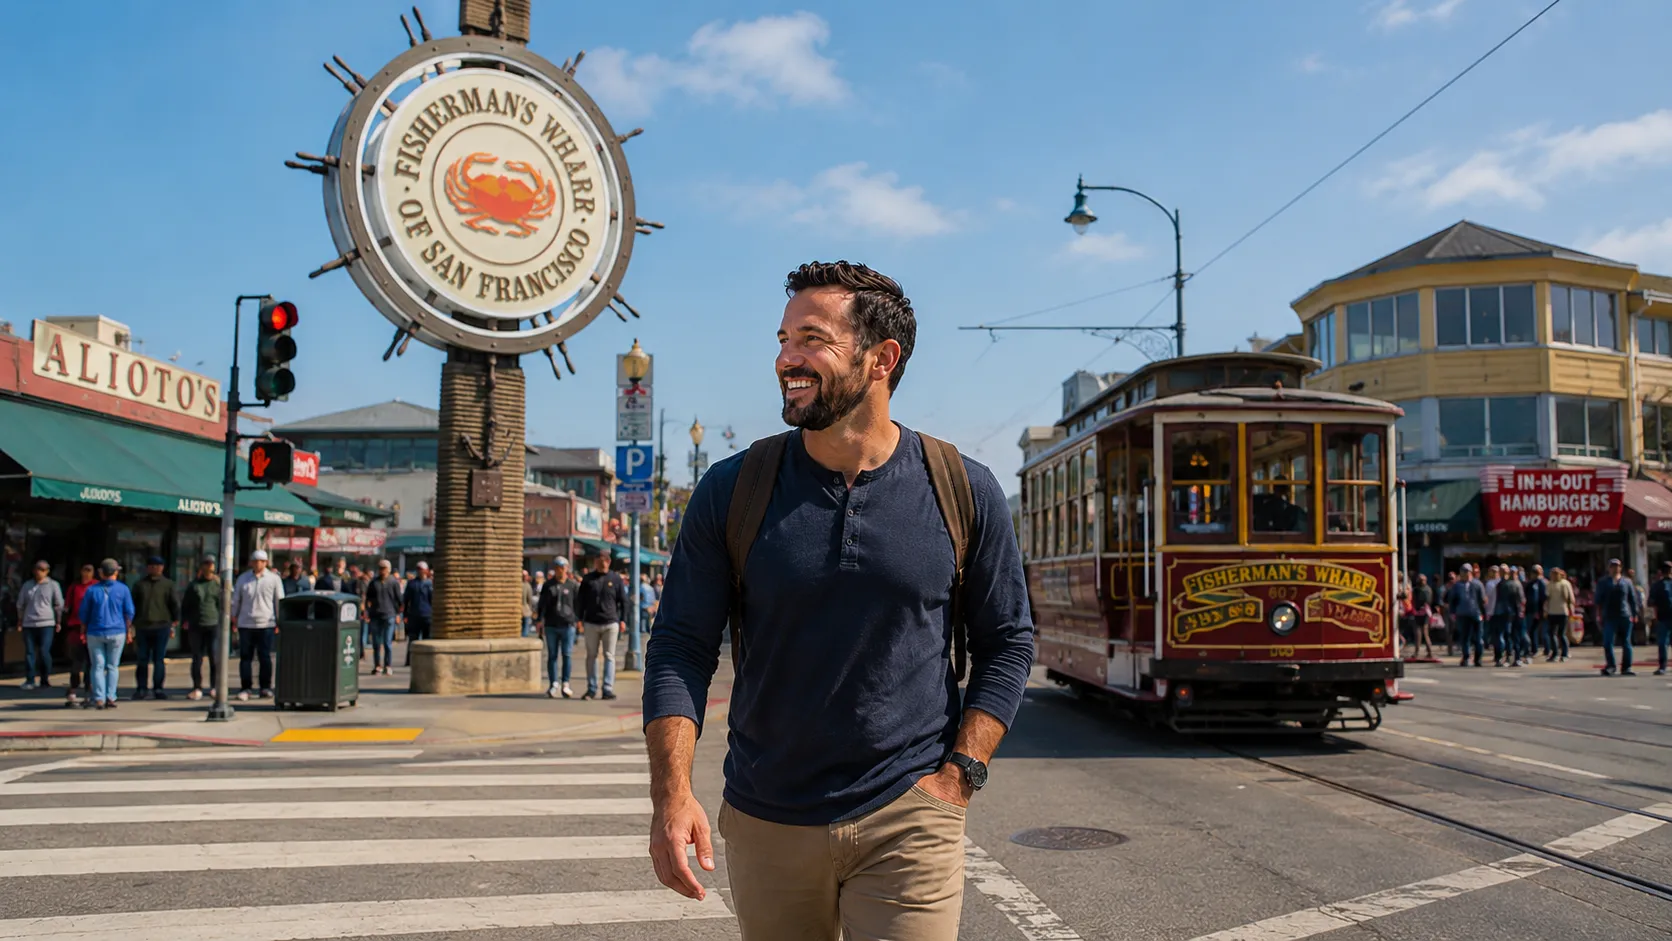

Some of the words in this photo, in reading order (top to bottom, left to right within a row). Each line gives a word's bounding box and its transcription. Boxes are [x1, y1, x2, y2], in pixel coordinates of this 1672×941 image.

[394, 87, 538, 182] FISHERMAN'S
[398, 198, 434, 240] OF
[420, 240, 473, 290] SAN
[476, 228, 591, 302] FRANCISCO
[41, 333, 217, 417] ALIOTO'S
[626, 448, 645, 476] P
[1517, 473, 1593, 490] IN-N-OUT
[1500, 493, 1610, 511] HAMBURGERS
[1519, 514, 1541, 527] NO
[1547, 514, 1593, 528] DELAY
[1189, 564, 1308, 593] FISHERMAN'S
